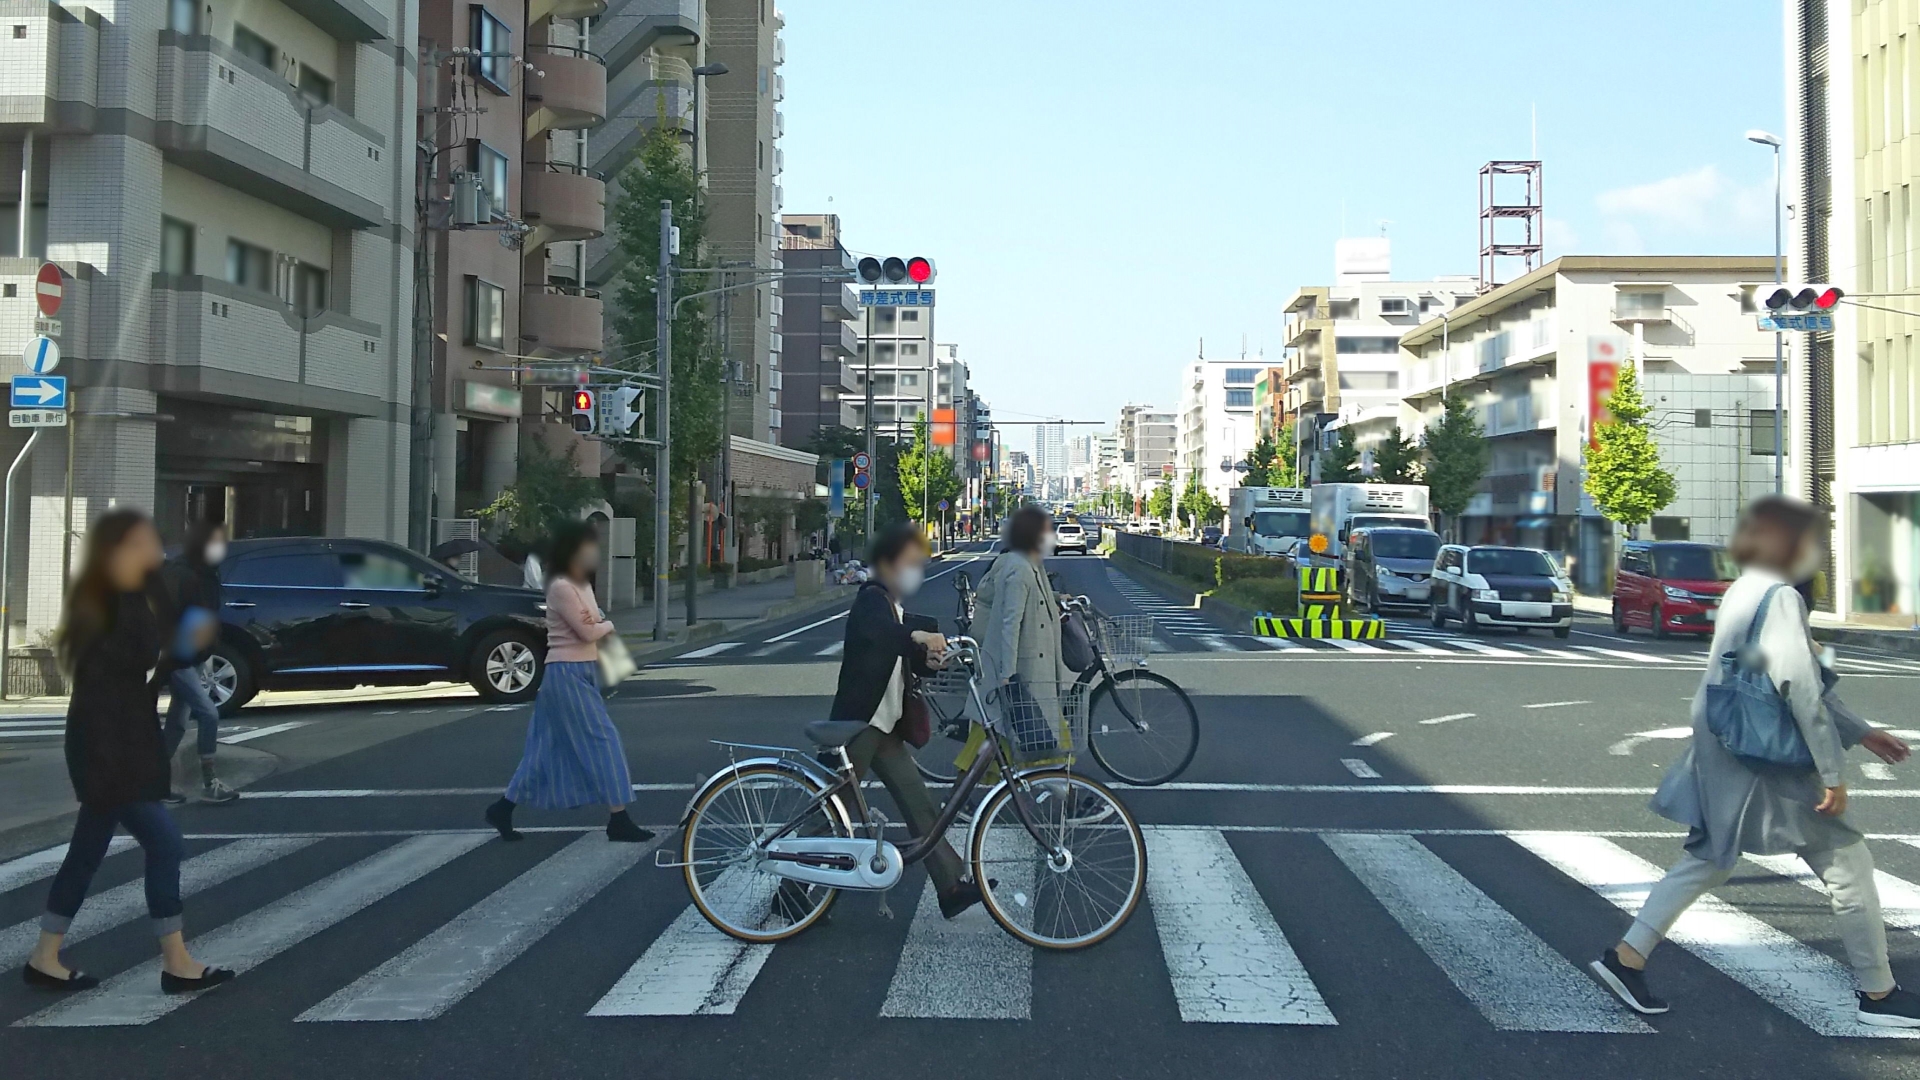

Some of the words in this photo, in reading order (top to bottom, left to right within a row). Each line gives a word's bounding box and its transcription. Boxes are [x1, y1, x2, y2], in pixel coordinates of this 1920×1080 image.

[861, 291, 933, 305] 時差式信号
[12, 413, 40, 424] 自動車
[45, 412, 64, 423] 原付
[857, 457, 868, 466] 50
